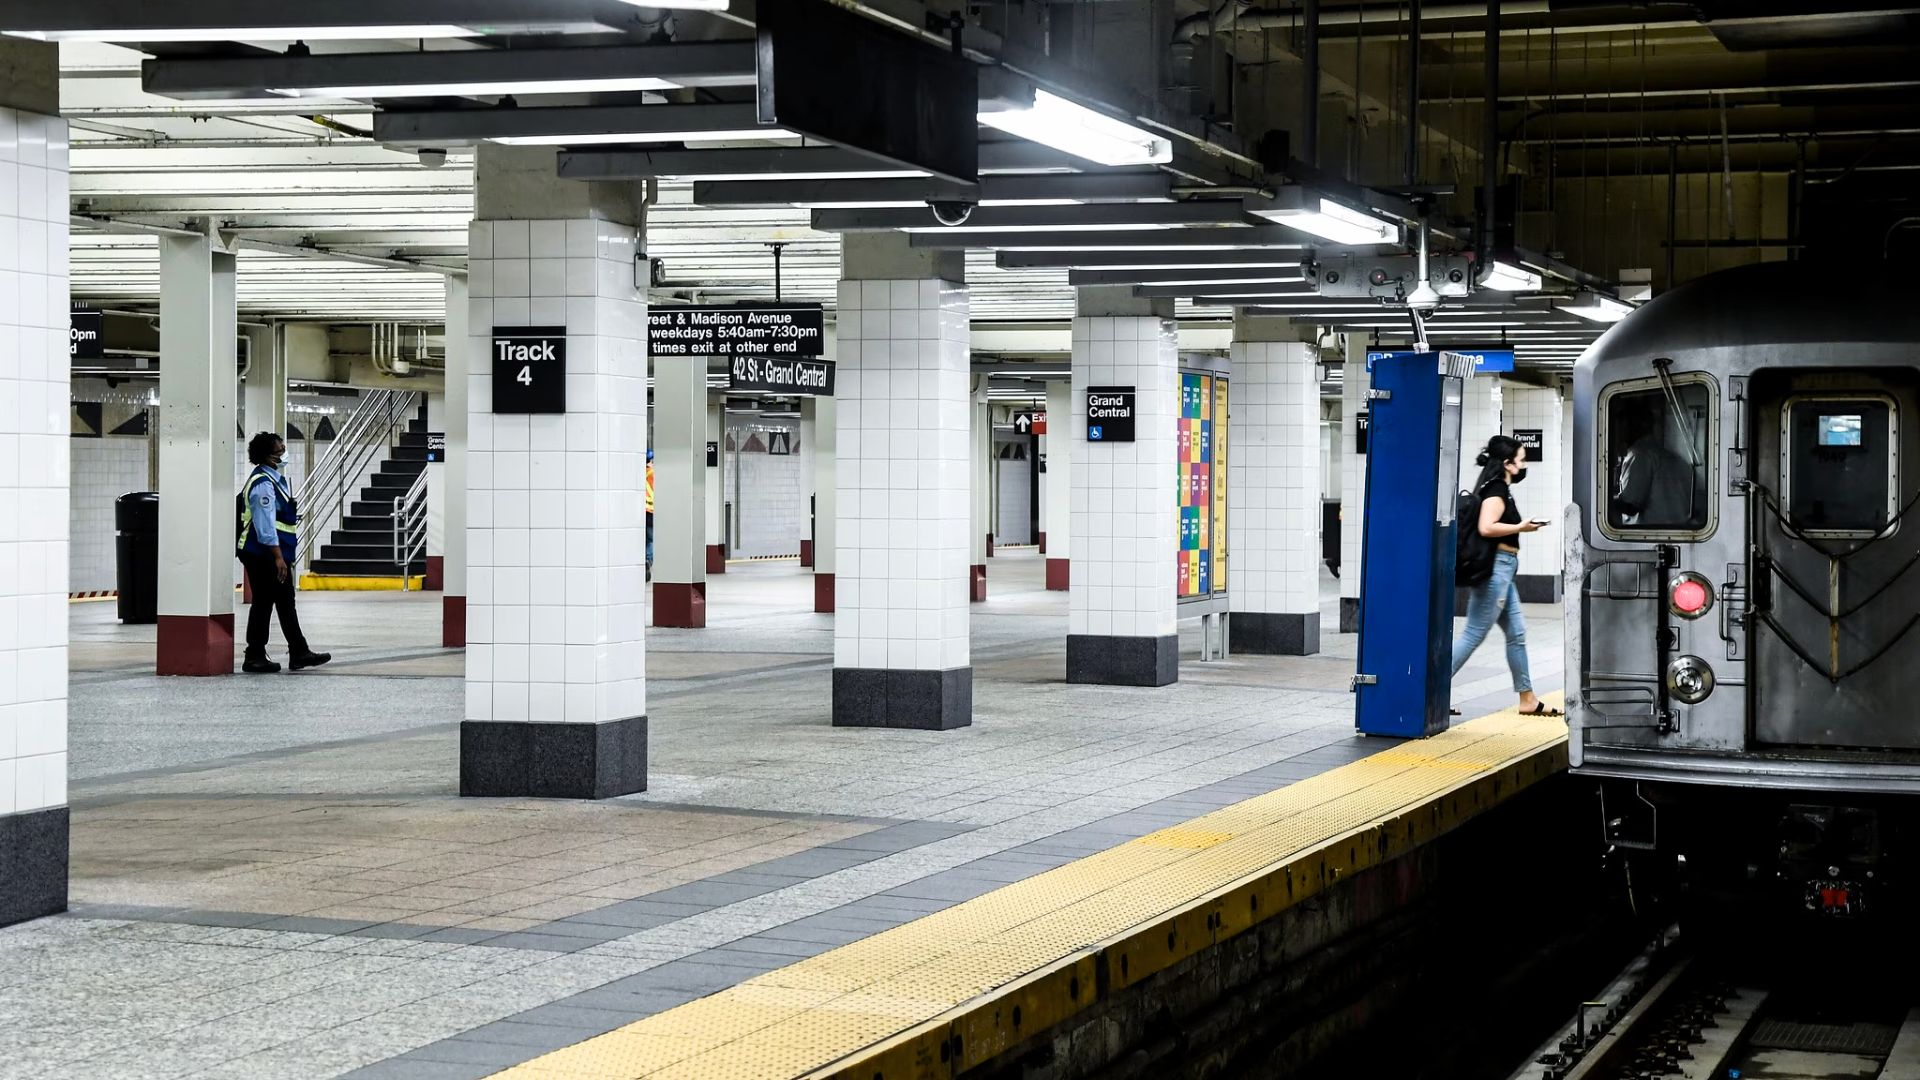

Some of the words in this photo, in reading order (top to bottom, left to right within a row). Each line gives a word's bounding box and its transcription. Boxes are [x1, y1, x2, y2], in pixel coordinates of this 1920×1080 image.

[676, 313, 686, 325] &
[691, 312, 743, 325] Madison
[747, 312, 792, 324] Avenue
[650, 326, 713, 340] weekdays
[717, 325, 817, 339] 5:40am-7:30pm
[495, 340, 556, 361] Track
[652, 341, 686, 353] times
[691, 341, 714, 353] exit
[718, 341, 731, 353] at
[736, 340, 769, 353] other
[773, 340, 797, 352] end
[516, 365, 532, 386] 4
[733, 356, 746, 381] 42
[747, 357, 759, 383] St
[765, 359, 794, 385] Grand
[795, 362, 827, 388] Central
[1089, 395, 1123, 406] Grand
[1089, 406, 1130, 418] Central
